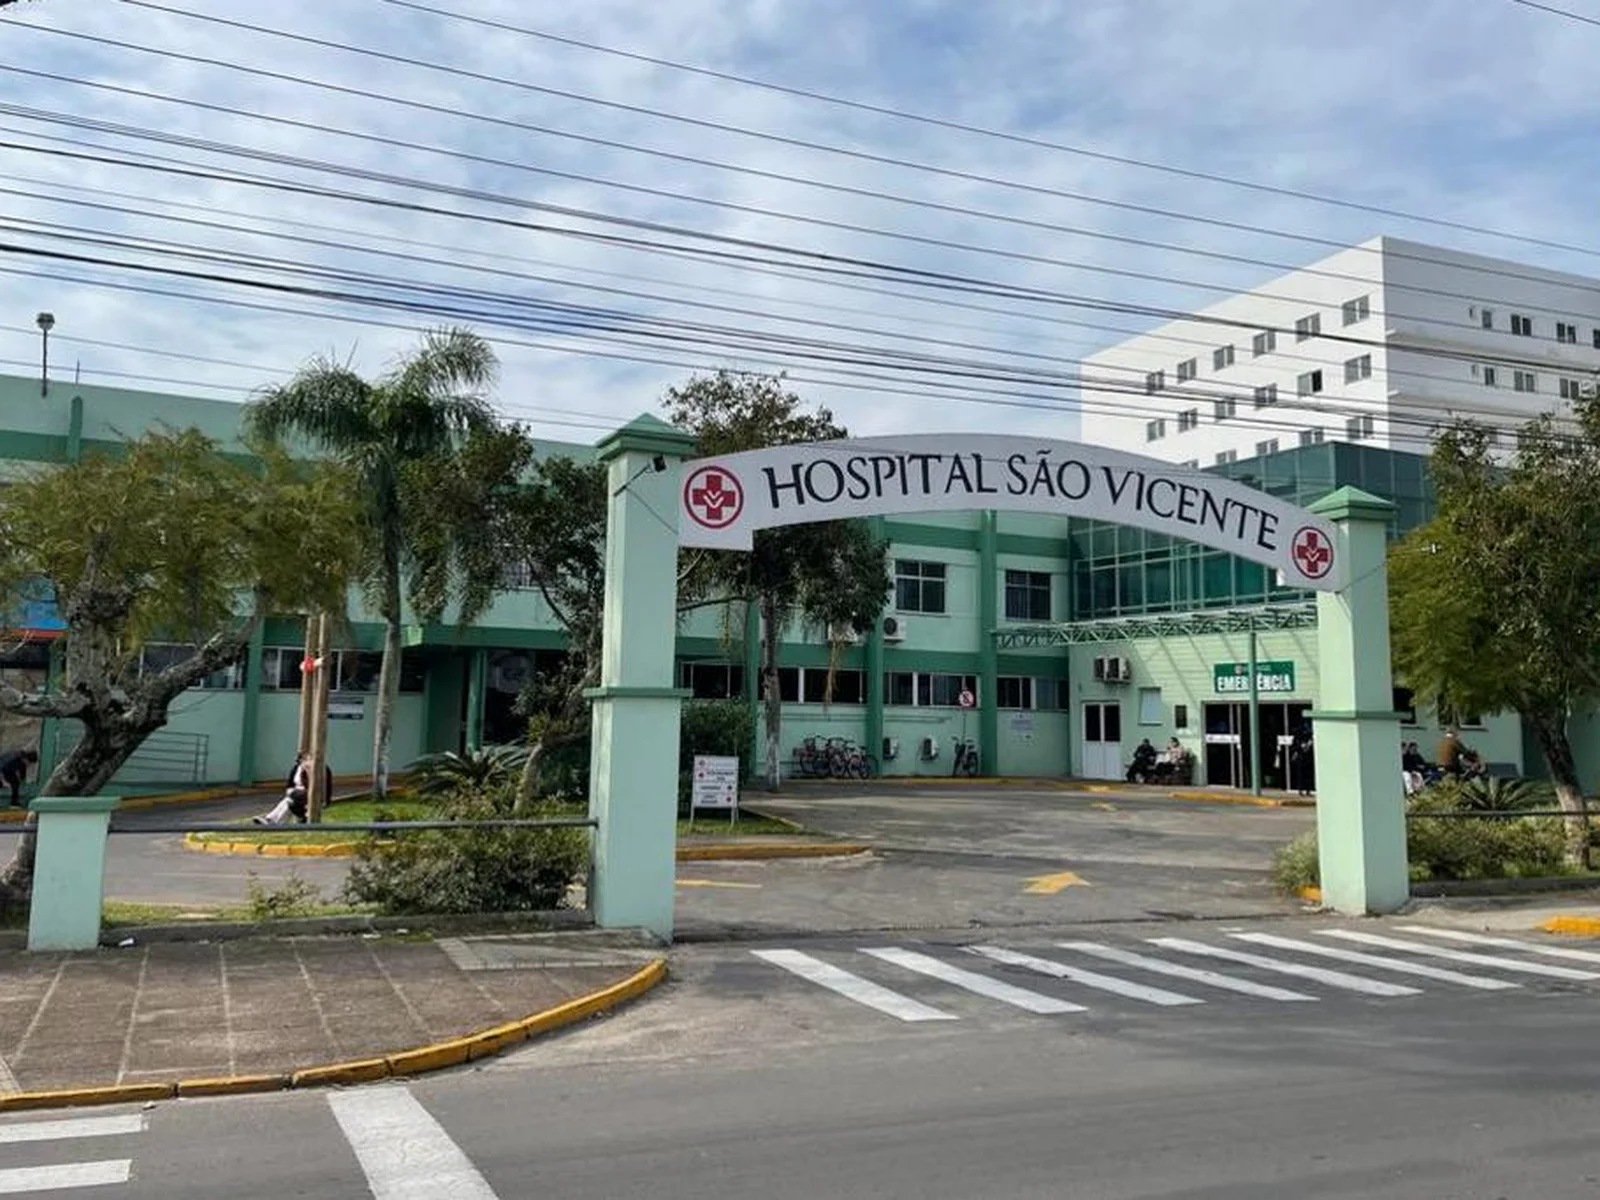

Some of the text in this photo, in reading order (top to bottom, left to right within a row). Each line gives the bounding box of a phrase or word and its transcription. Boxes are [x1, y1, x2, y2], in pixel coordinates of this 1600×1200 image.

[762, 450, 1279, 551] HOSPITAL SÃO VICENTE
[1217, 673, 1292, 691] EMERÊNCIA
